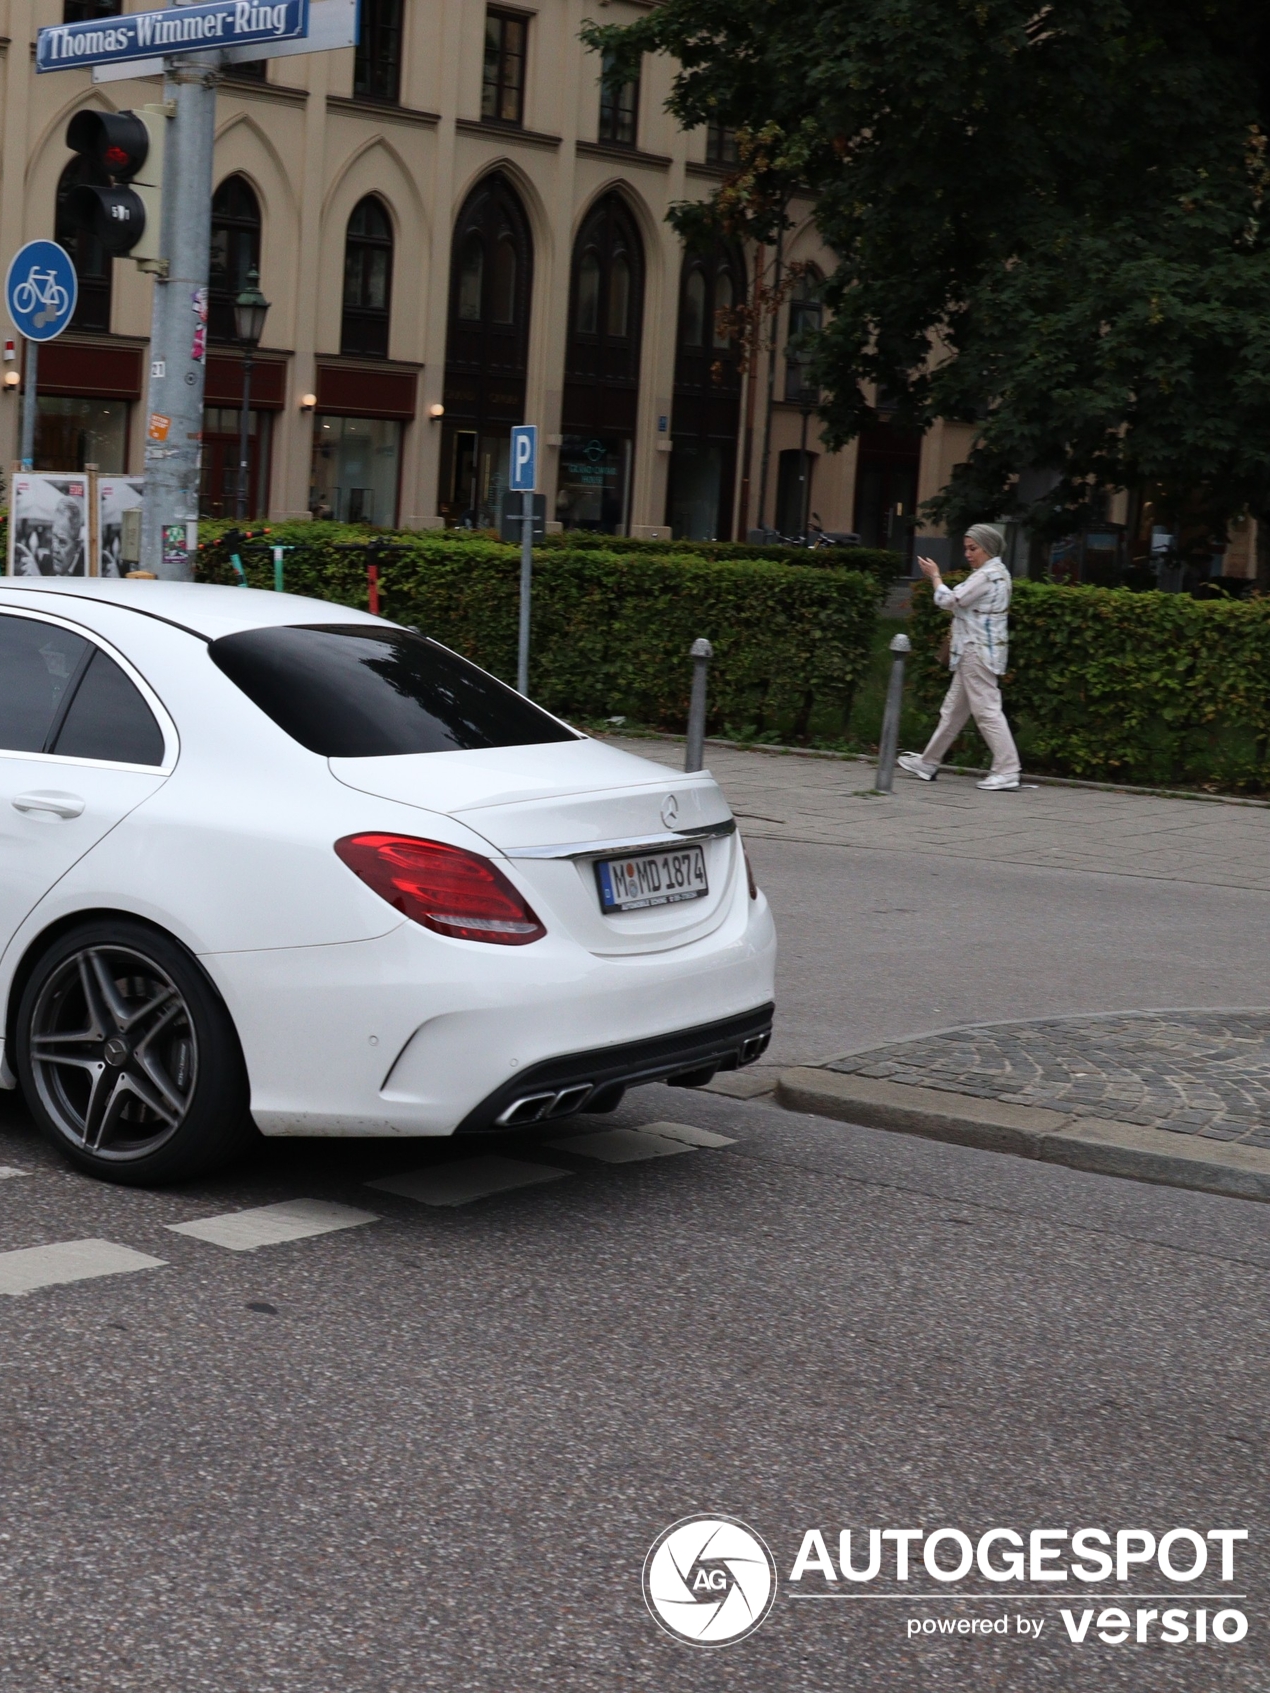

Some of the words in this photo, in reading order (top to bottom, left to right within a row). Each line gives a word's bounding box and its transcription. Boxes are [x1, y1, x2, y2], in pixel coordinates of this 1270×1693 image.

[48, 1, 288, 60] Thomas-Wimmer-Ring
[515, 435, 531, 482] P
[612, 863, 629, 898] M
[636, 859, 661, 894] MD
[662, 852, 704, 889] 1874
